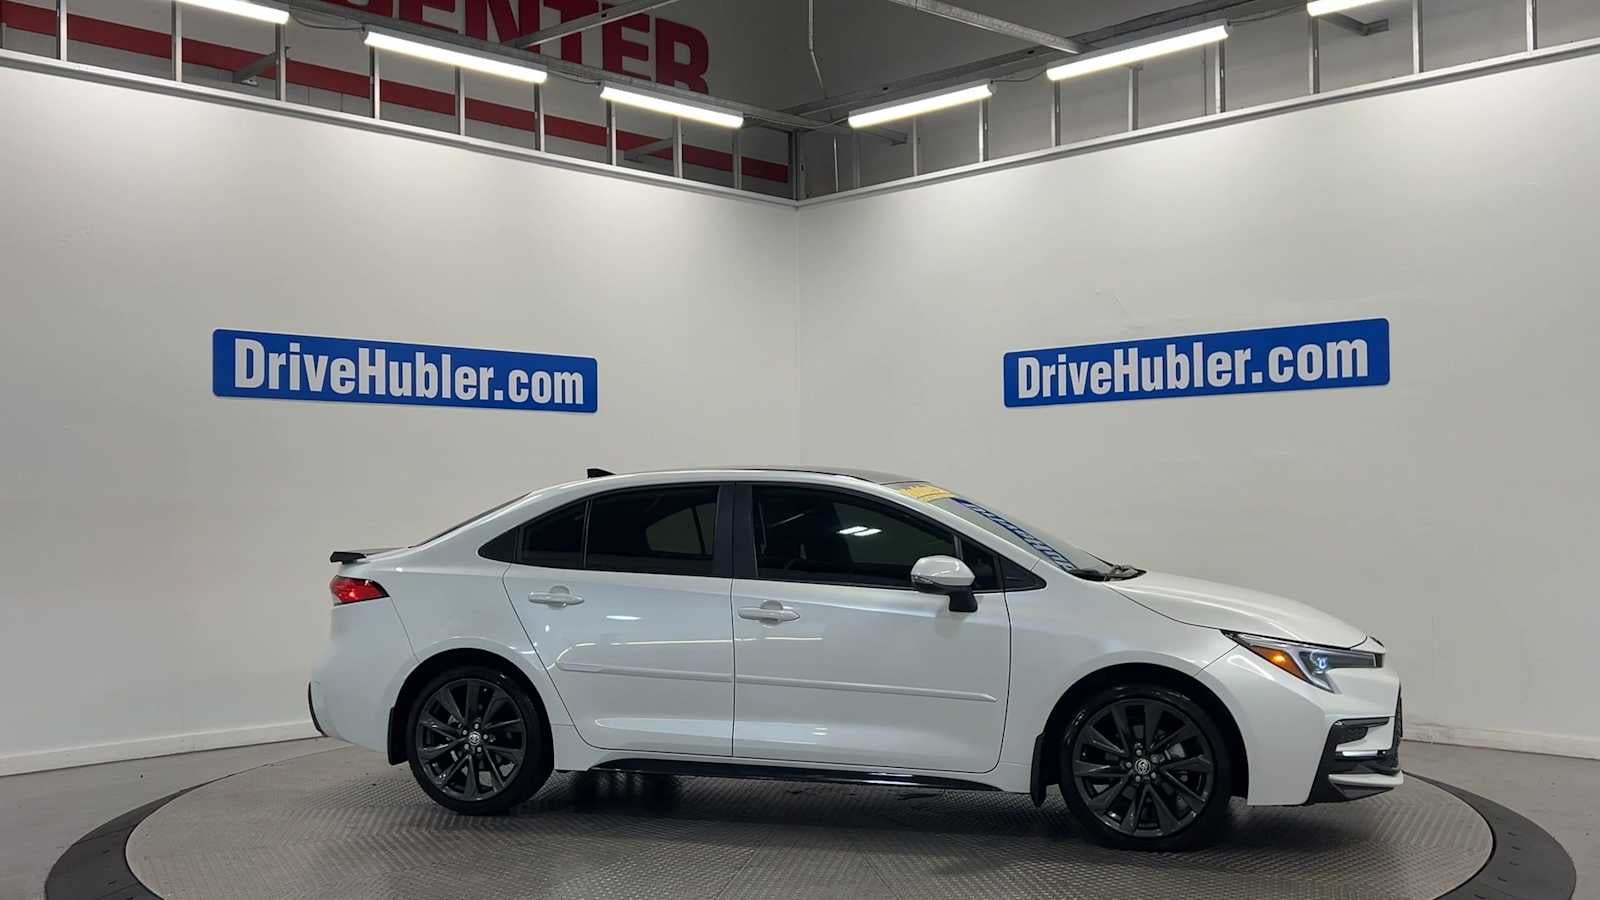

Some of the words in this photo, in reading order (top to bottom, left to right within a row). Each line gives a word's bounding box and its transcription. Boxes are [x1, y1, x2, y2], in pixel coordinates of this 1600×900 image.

[319, 0, 709, 97] NTER
[234, 337, 584, 405] DriveHubler.com
[1017, 337, 1369, 399] DriveHubler.com
